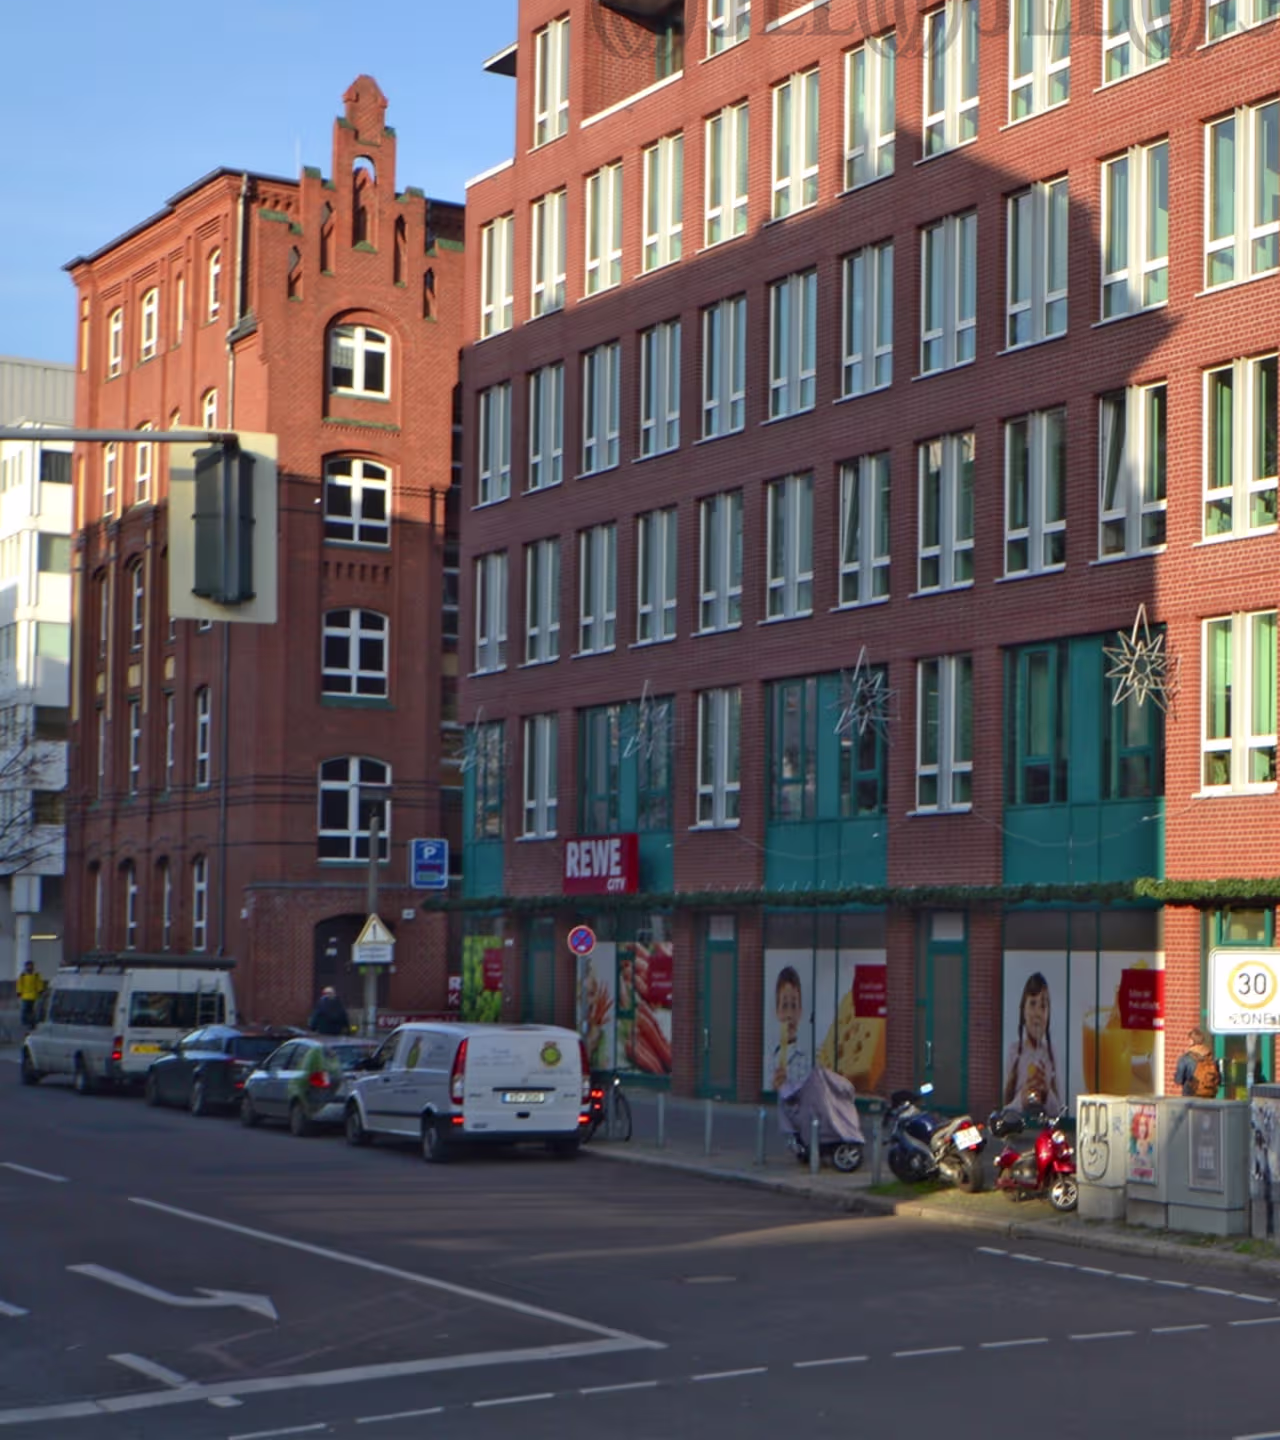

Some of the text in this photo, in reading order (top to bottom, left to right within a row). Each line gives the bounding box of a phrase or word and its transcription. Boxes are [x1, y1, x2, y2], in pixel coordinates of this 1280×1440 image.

[566, 838, 622, 878] REWE
[607, 877, 627, 890] CITY
[1238, 973, 1267, 995] 30
